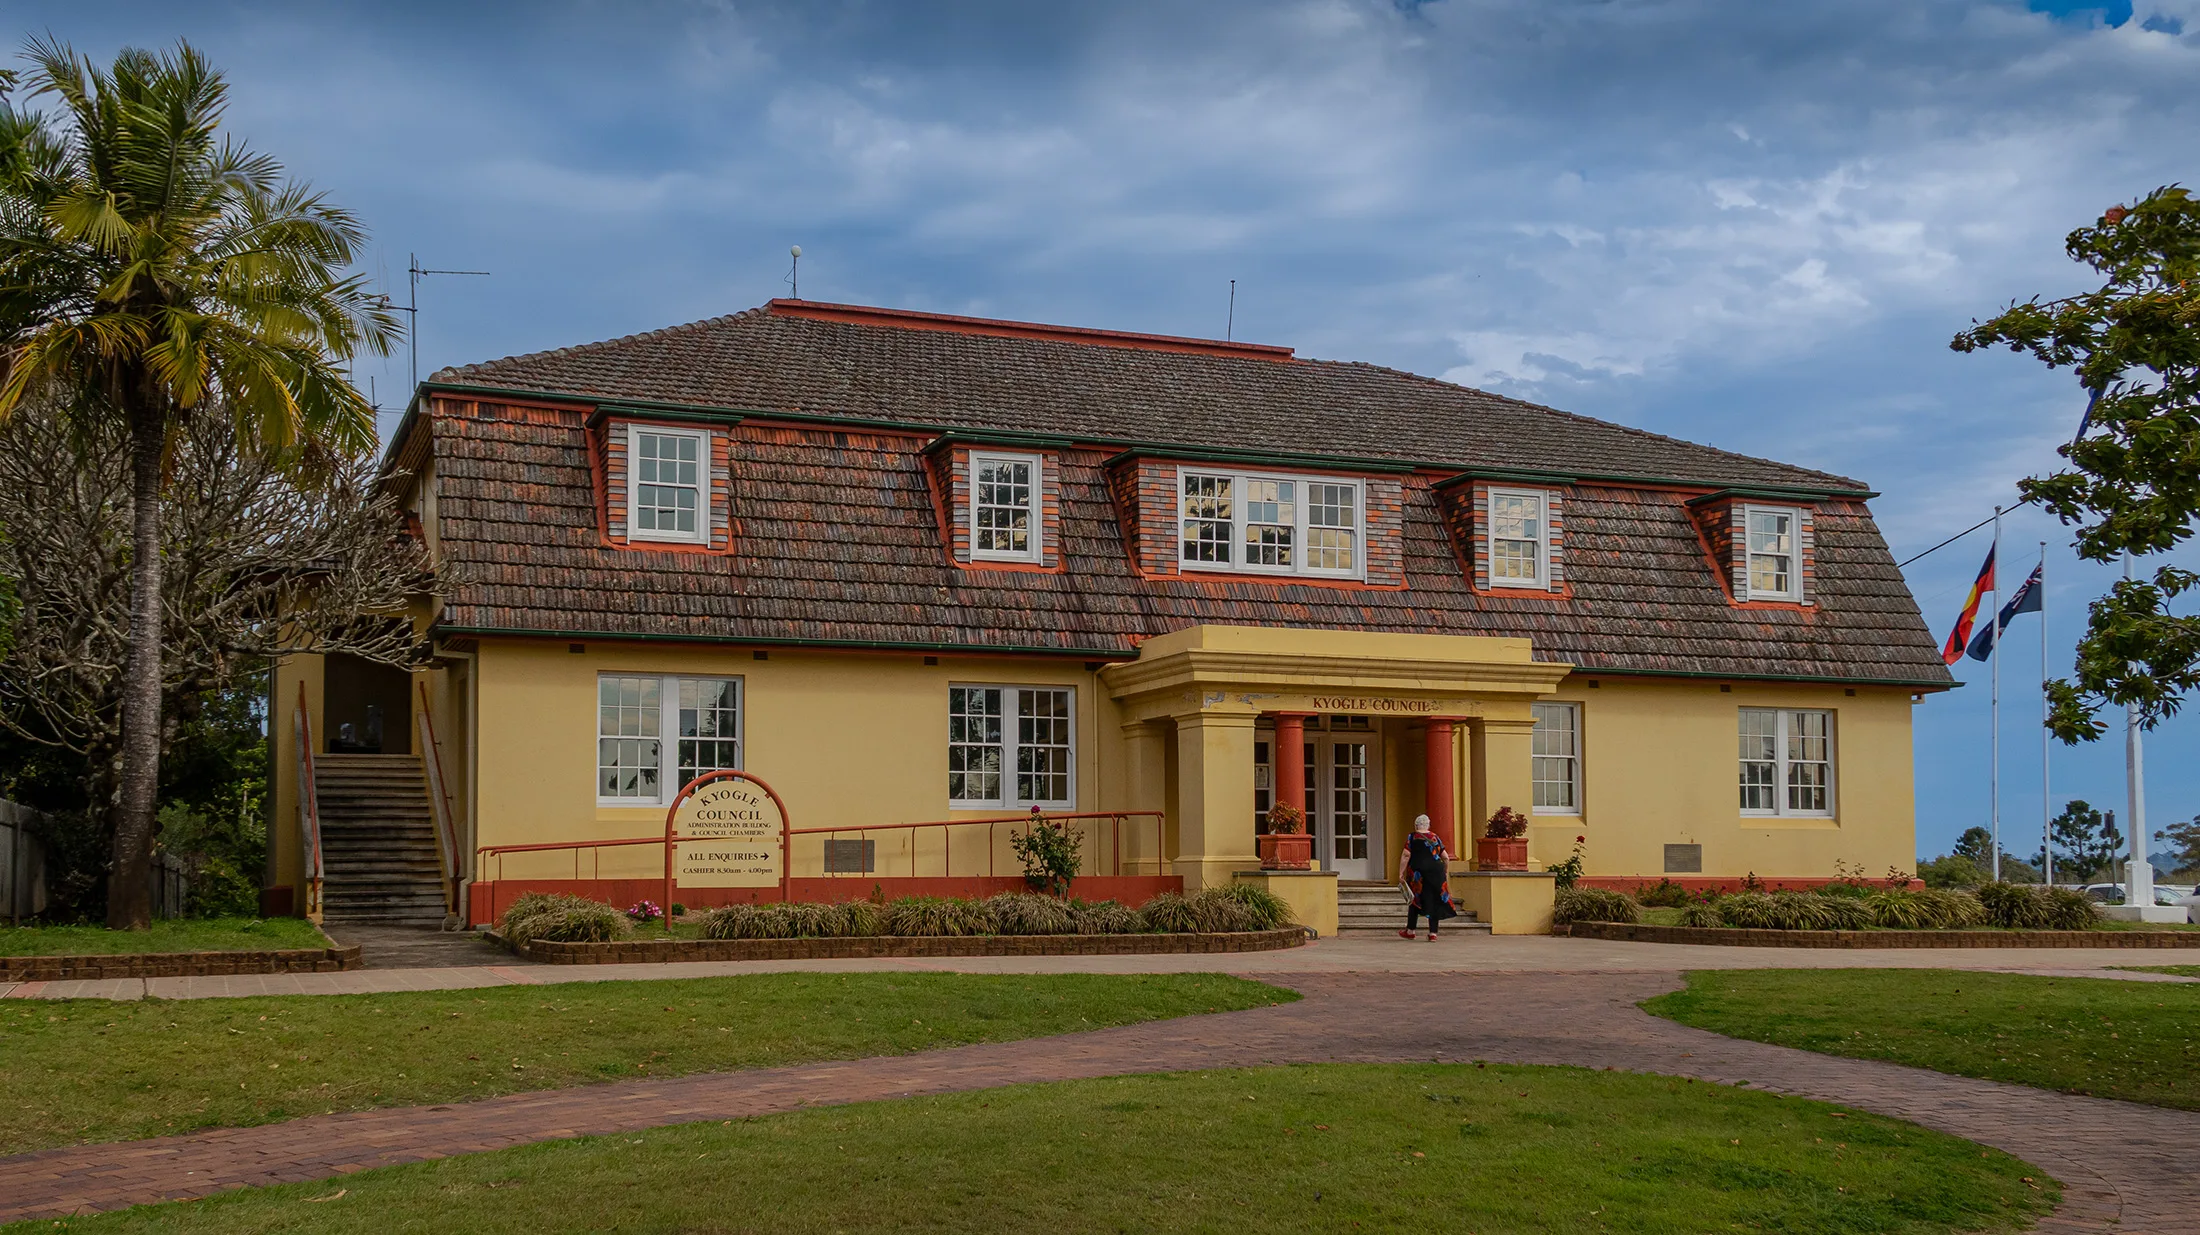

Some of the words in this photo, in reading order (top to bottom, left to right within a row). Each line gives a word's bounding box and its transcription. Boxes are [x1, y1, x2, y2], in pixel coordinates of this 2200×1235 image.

[1313, 697, 1367, 710] KYOGLE
[700, 789, 759, 807] KYOGLE
[697, 810, 762, 820] COUNCIL
[687, 853, 705, 861] ALL
[708, 853, 758, 862] ENQUIRIES
